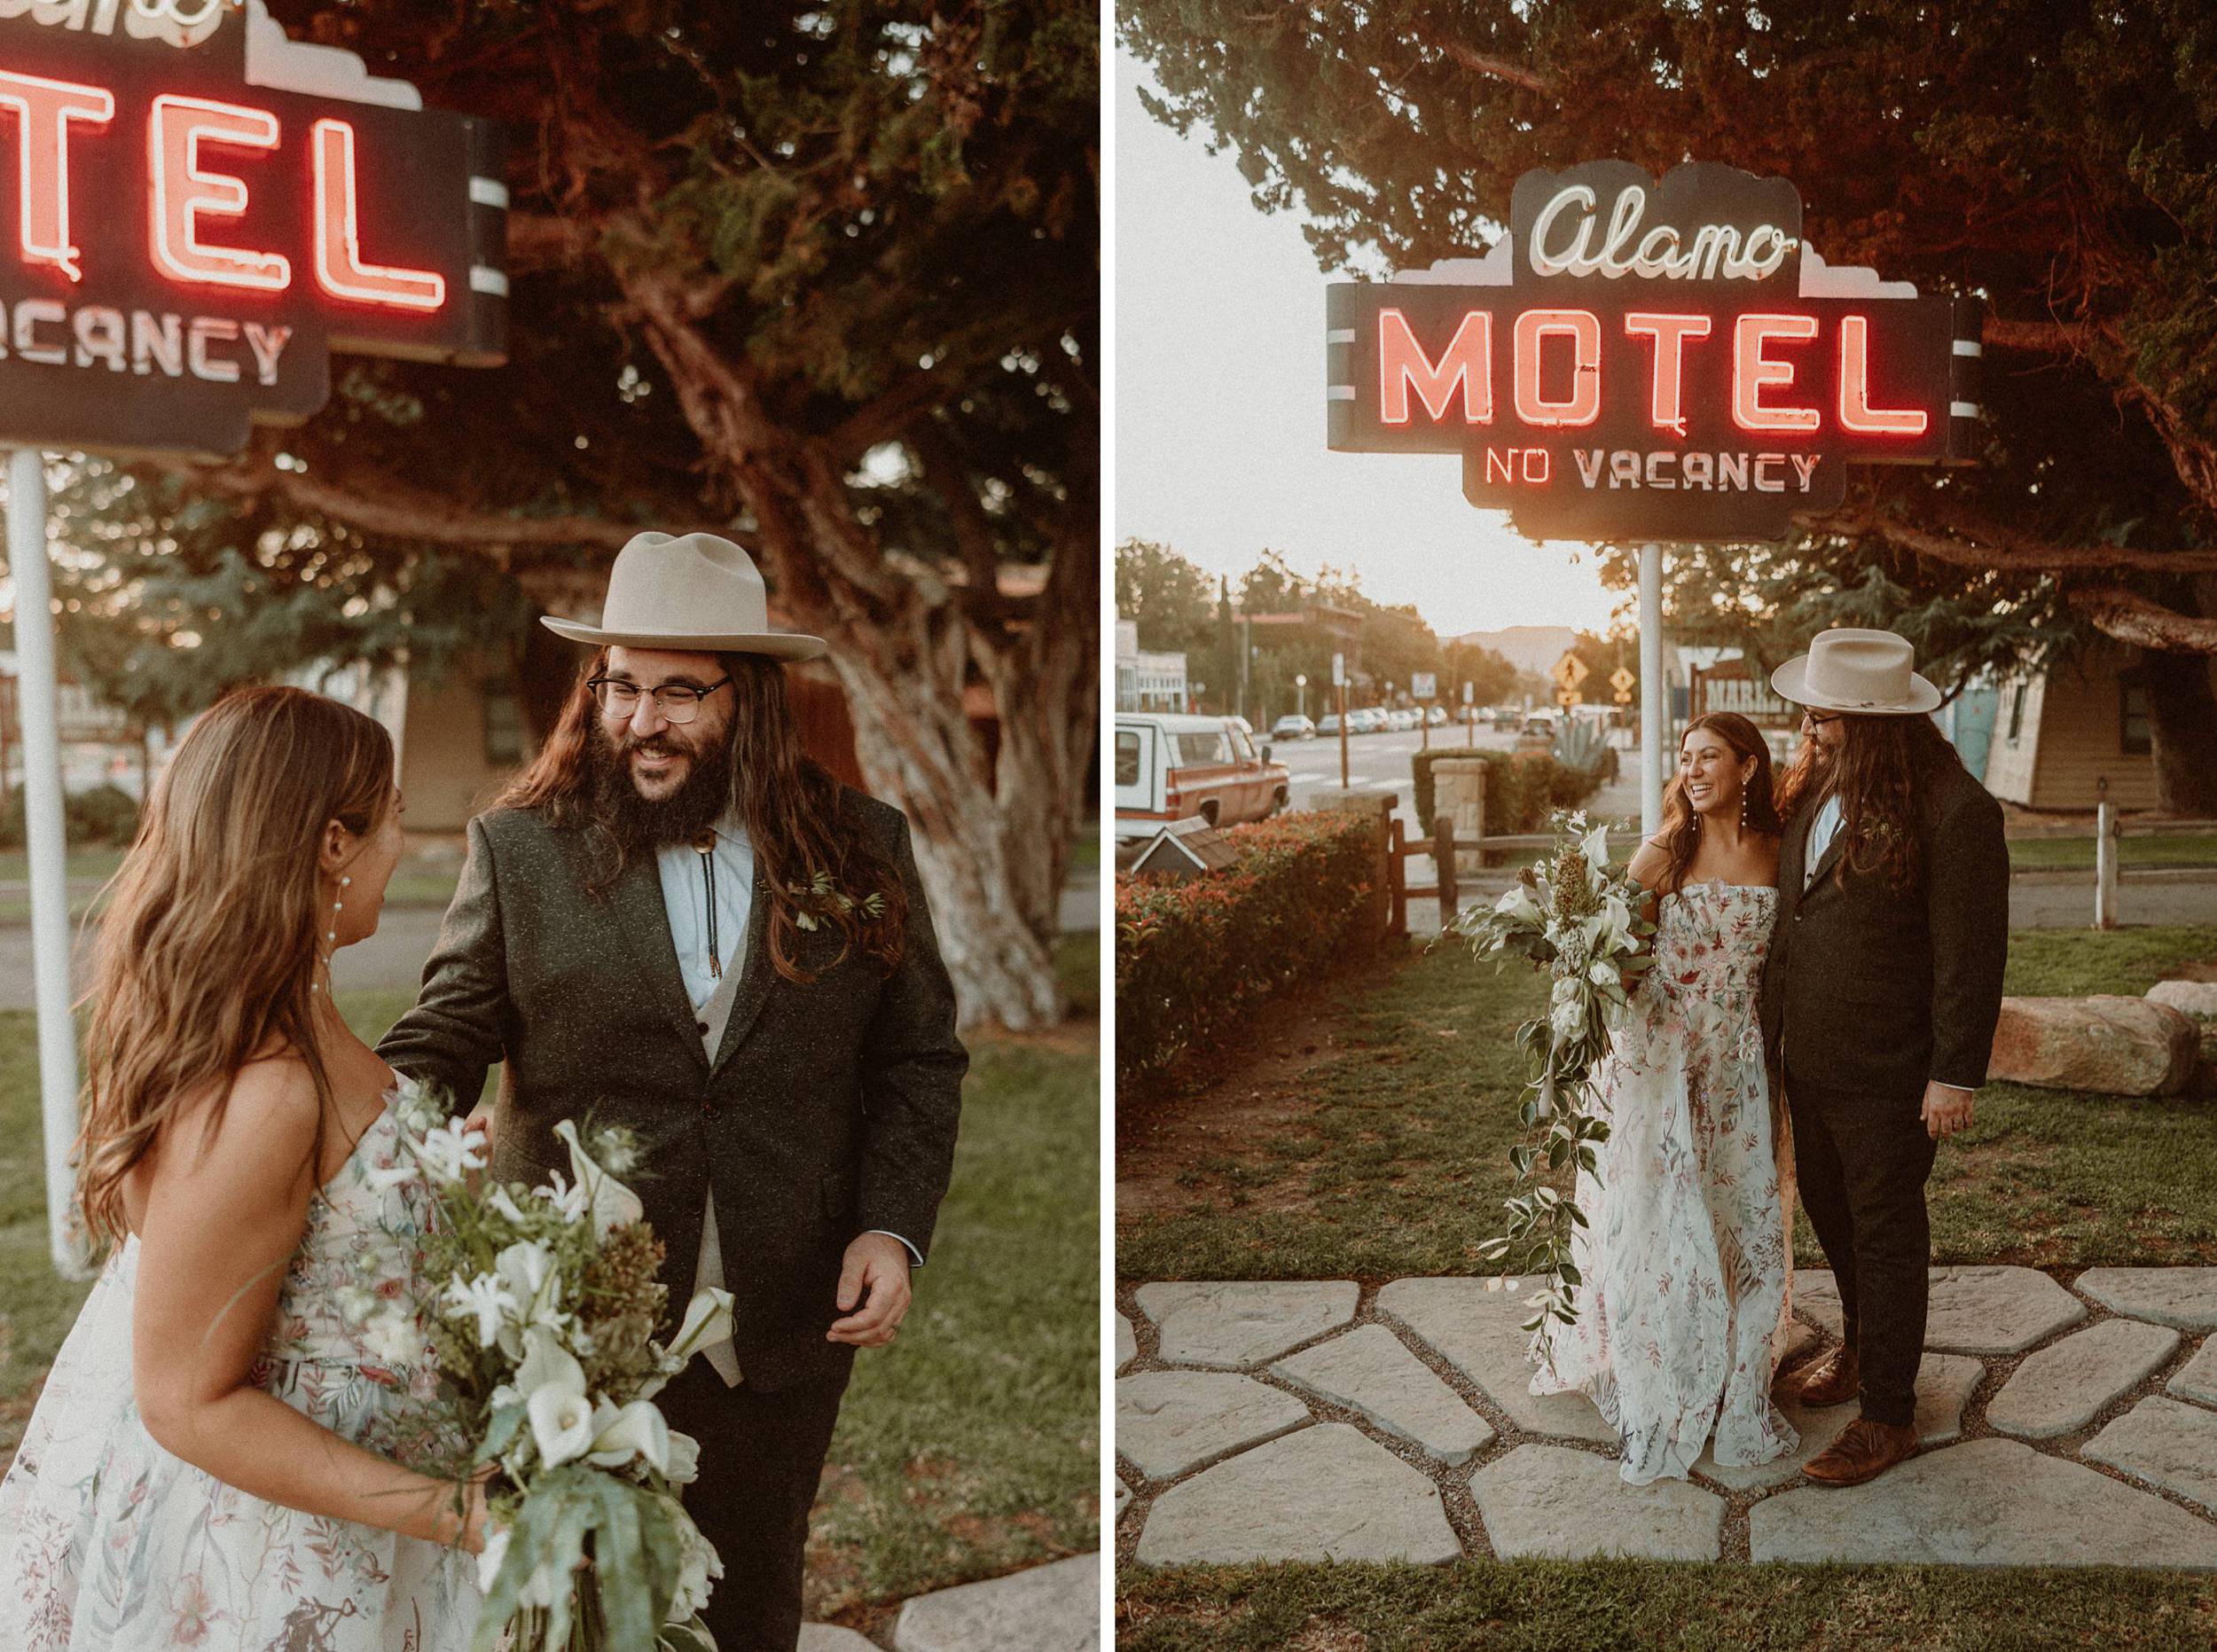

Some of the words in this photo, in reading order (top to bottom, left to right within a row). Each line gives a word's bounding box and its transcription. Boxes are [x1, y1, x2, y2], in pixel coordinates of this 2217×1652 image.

[1529, 184, 1799, 281] Alamo
[0, 297, 294, 386] CANCY
[1378, 308, 1929, 436] MOTEL
[1486, 447, 1549, 484] NO
[1572, 449, 1821, 493] VACANCY
